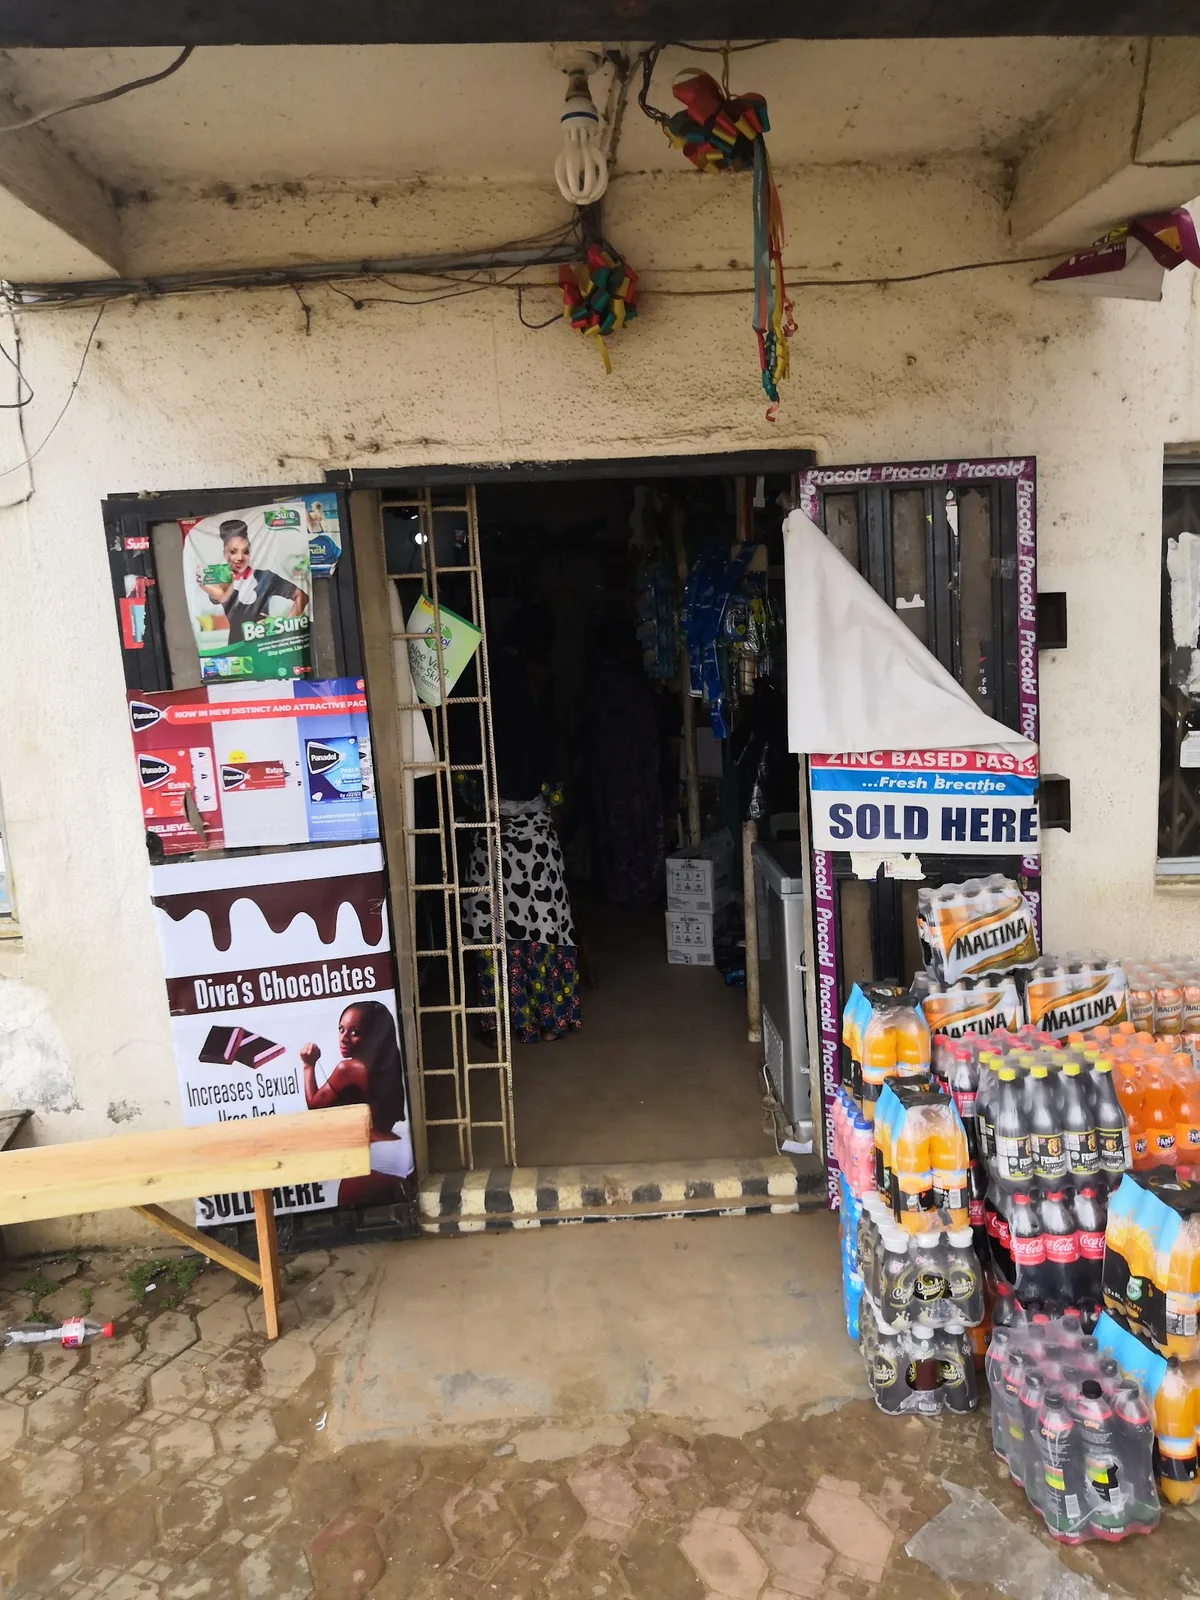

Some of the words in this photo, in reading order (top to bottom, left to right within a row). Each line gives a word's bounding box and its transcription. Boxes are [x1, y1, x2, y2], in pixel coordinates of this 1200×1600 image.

[806, 466, 872, 485] Procold
[881, 463, 948, 480] Procold
[956, 459, 1026, 478] Procold
[1018, 479, 1035, 547] Procold
[422, 600, 432, 609] NE
[1020, 555, 1036, 622] Procold
[243, 615, 309, 641] Be2Sure
[425, 627, 451, 648] Dtol
[409, 644, 427, 662] Aloe
[428, 656, 450, 678] Vea.
[1020, 629, 1037, 695] Procold
[133, 711, 159, 720] Panadol
[174, 710, 197, 719] NOW
[198, 709, 209, 718] IN
[208, 707, 230, 716] NEW
[231, 705, 271, 715] DISTINCT
[272, 704, 292, 713] AND
[293, 701, 346, 711] ATTRACTIVE
[1022, 702, 1037, 741] Proc
[310, 753, 337, 762] Panadol
[826, 752, 884, 765] ZINC
[891, 751, 968, 767] BASED
[933, 775, 1007, 792] Breathe
[828, 803, 929, 840] SOLD
[940, 807, 1038, 843] HERE
[814, 850, 832, 900] rocold
[816, 906, 833, 968] Procold
[955, 916, 1029, 961] MALTINA
[193, 975, 255, 1010] Diva's
[258, 964, 376, 1002] Chocolates
[819, 973, 837, 1034] Procold
[1041, 994, 1118, 1033] MALTINA
[186, 1081, 254, 1108] Increases
[255, 1067, 300, 1099] Sexual
[821, 1039, 838, 1097] Procold
[1156, 1135, 1175, 1147] FANT
